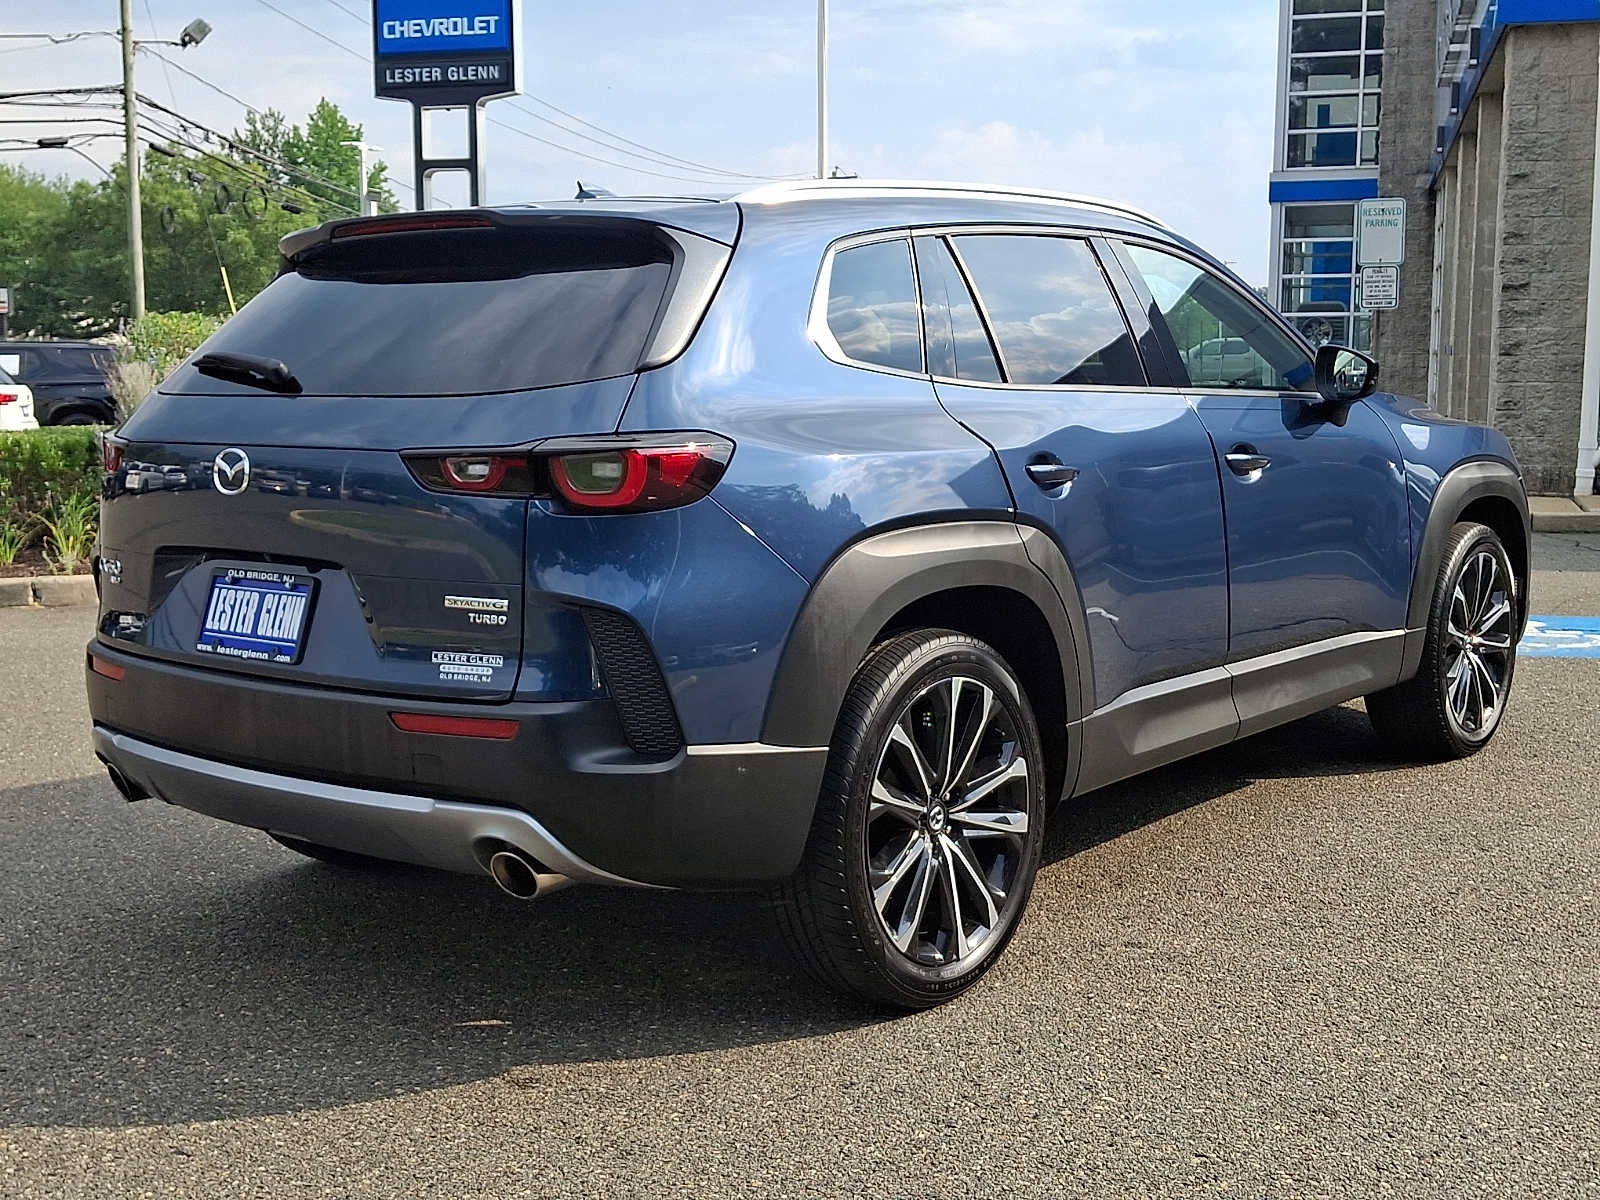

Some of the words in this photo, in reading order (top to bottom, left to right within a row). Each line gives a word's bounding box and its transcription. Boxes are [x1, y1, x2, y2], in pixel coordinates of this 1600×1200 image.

[383, 16, 499, 39] CHEVROLET
[386, 67, 442, 83] LESTER
[448, 65, 499, 81] GLENN
[1363, 207, 1402, 216] RESERVED
[1365, 219, 1398, 227] PARKING
[228, 569, 245, 579] OLD
[282, 574, 295, 583] NJ
[205, 587, 260, 634] LESTER
[256, 593, 306, 640] GLENN
[468, 613, 507, 625] TURBO
[432, 653, 467, 662] LESTER
[469, 655, 503, 664] GLENN
